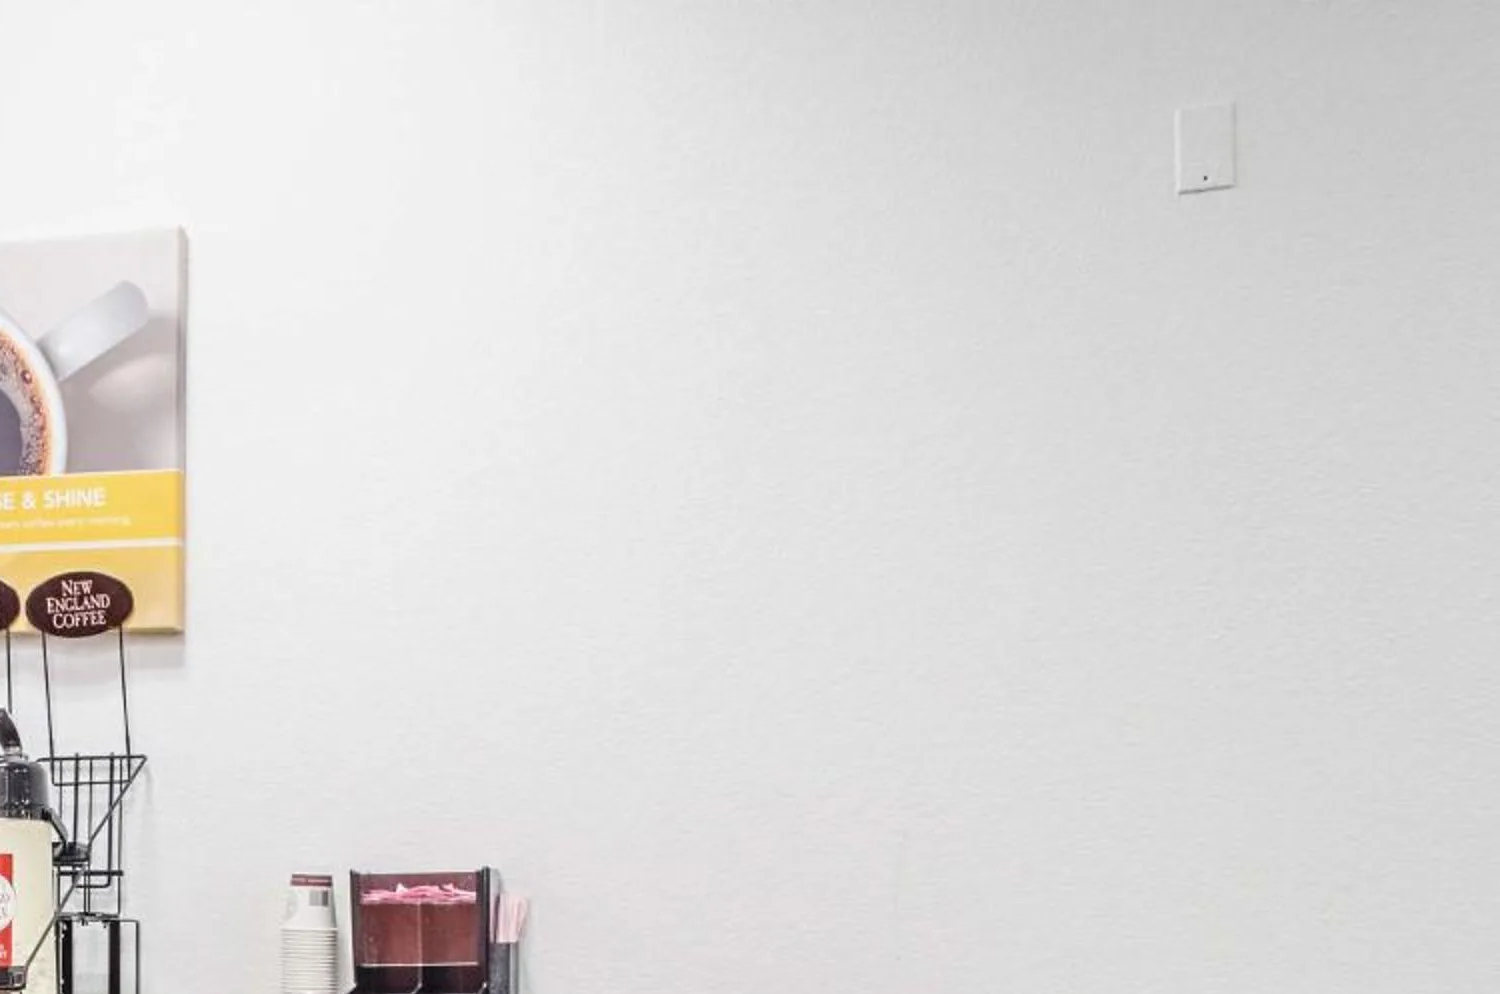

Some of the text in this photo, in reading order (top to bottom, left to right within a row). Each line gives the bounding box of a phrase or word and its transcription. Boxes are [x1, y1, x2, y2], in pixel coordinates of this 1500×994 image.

[22, 491, 36, 510] &
[43, 487, 107, 510] SHINE
[61, 579, 93, 598] NEW
[47, 594, 111, 614] ENGLAND
[52, 611, 107, 629] COFFEE
